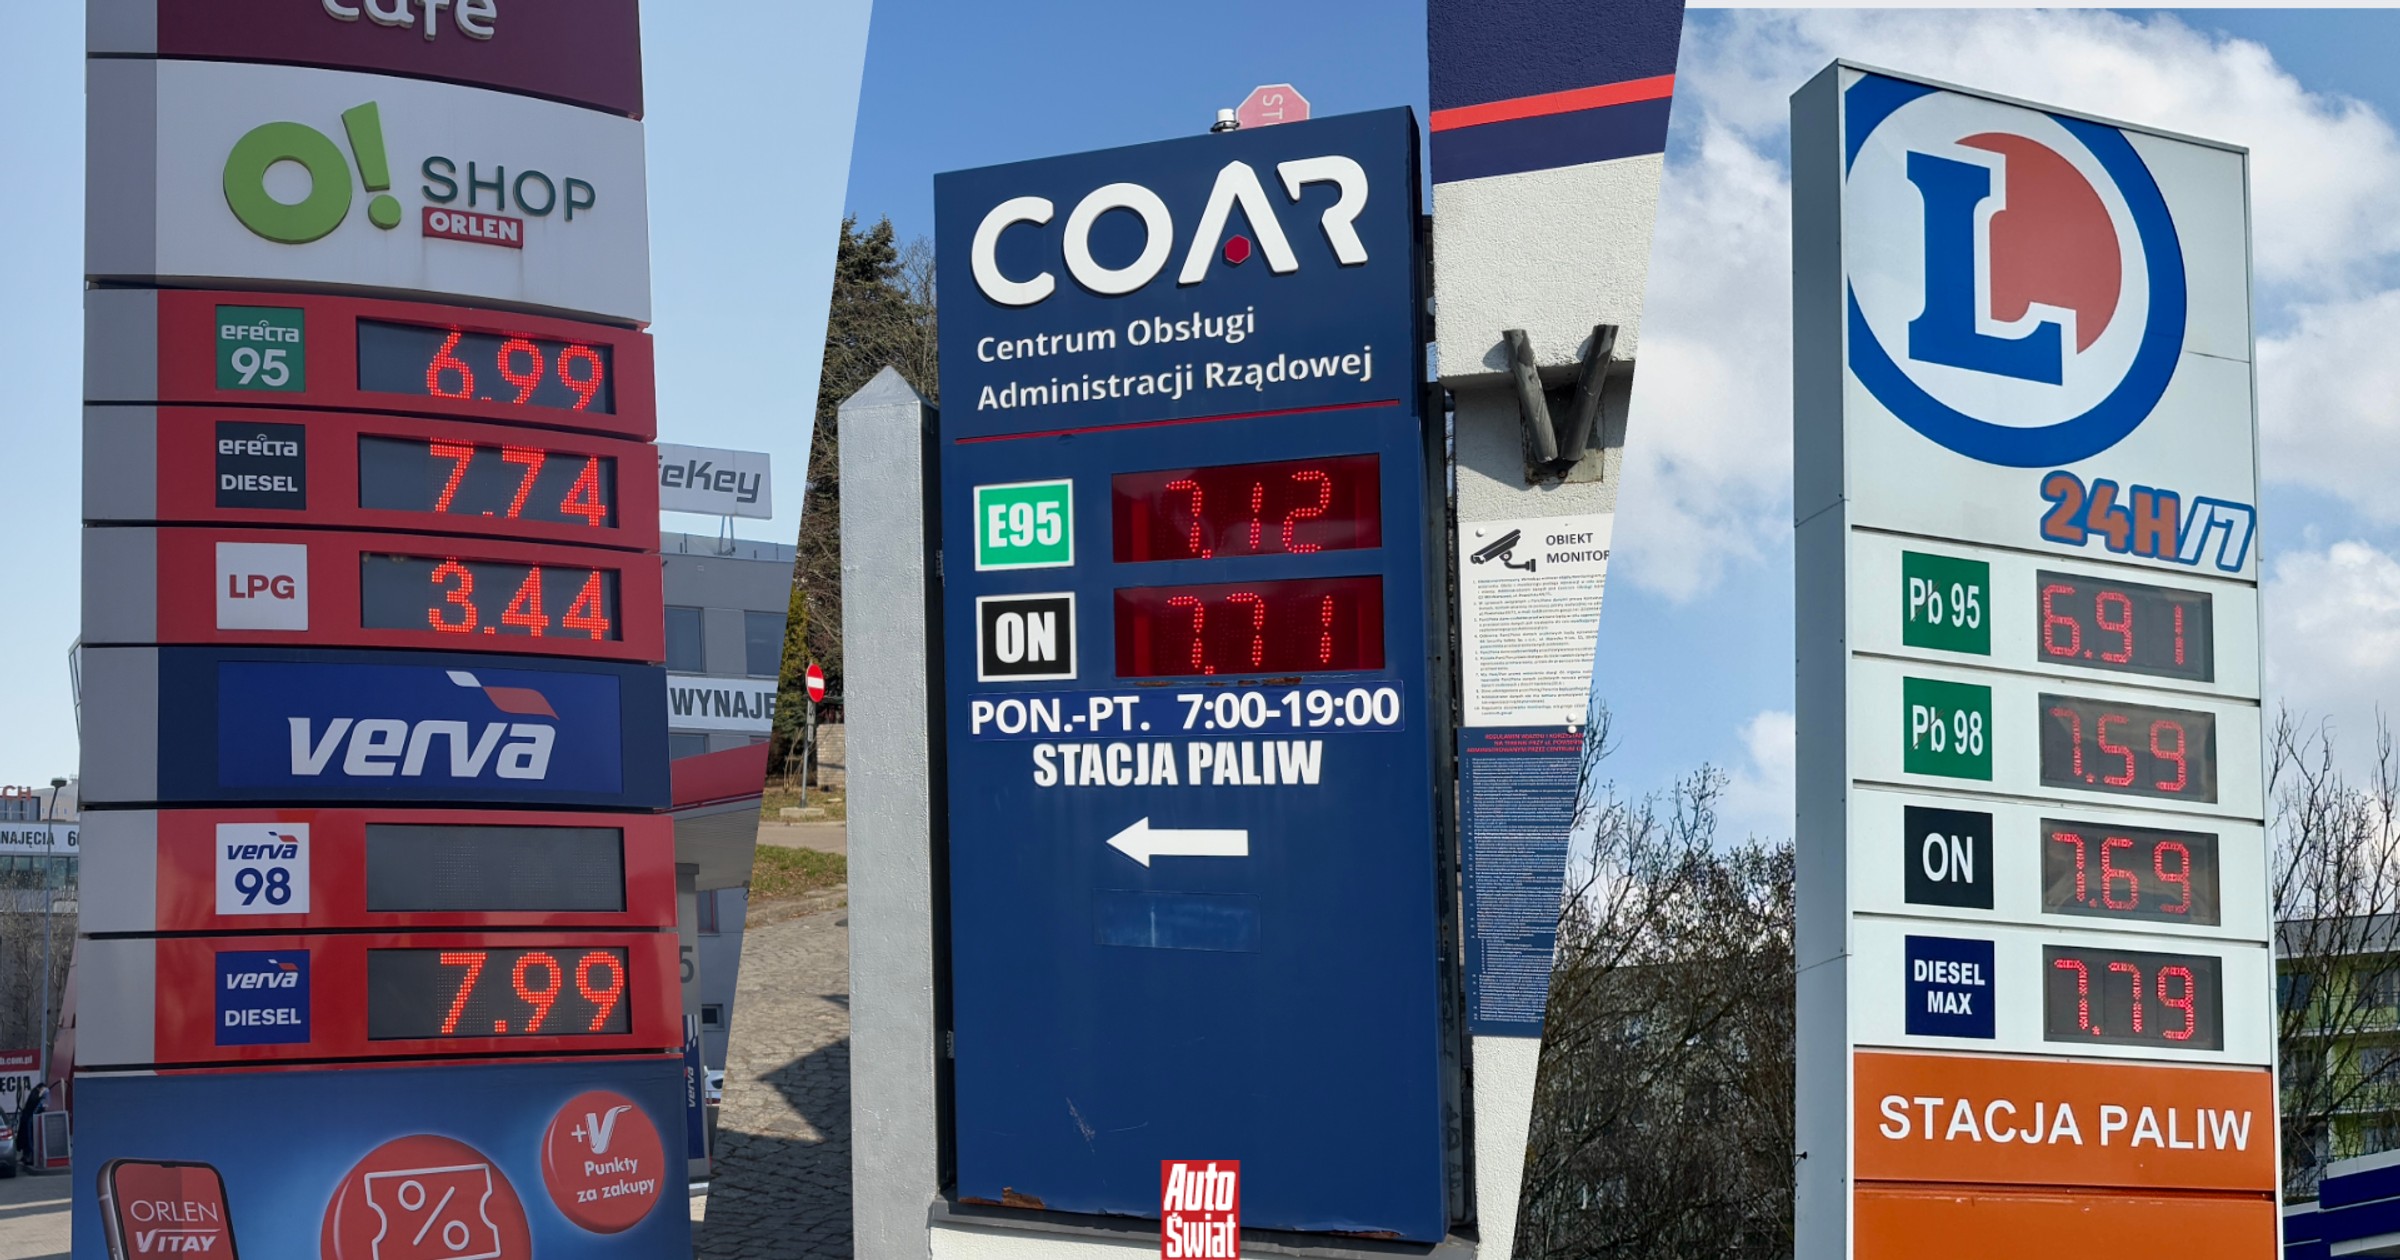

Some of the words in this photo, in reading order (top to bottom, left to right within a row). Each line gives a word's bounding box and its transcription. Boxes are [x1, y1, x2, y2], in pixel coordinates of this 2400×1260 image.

[1262, 94, 1283, 126] ST
[223, 101, 401, 244] O!
[421, 156, 596, 222] SHOP
[428, 211, 519, 243] ORLEN
[971, 155, 1368, 306] COAR
[977, 325, 1116, 363] Centrum
[1127, 307, 1256, 346] Obsługi
[231, 347, 289, 387] 95
[426, 324, 603, 410] 6.99
[977, 363, 1193, 411] Administracji
[1205, 346, 1372, 392] Rządowej
[221, 474, 298, 492] DIESEL
[430, 437, 607, 526] 7.74
[658, 455, 761, 503] eKey
[987, 501, 1062, 548] E95
[1166, 470, 1331, 559] 7.12
[1546, 532, 1594, 546] OBIEKT
[2041, 470, 2256, 573] 24H/7
[229, 574, 295, 600] LPG
[428, 556, 609, 640] 3.44
[1910, 577, 1943, 624] Pb
[1951, 582, 1981, 629] 95
[995, 612, 1057, 662] ON
[1167, 592, 1332, 674] 7.71
[2042, 584, 2184, 665] 6.91
[971, 698, 1150, 735] PON.-PT.
[1177, 688, 1400, 731] 7:00-19:00
[1912, 705, 1946, 752] Pb
[1953, 709, 1983, 756] 98
[287, 717, 556, 780] verva
[1034, 742, 1178, 786] STACJA
[1189, 740, 1322, 785] PALIW
[2049, 707, 2186, 791] 7.59
[67, 830, 79, 847] 6
[227, 842, 298, 861] verva
[1922, 832, 1973, 883] ON
[234, 867, 291, 906] 98
[2052, 832, 2190, 914] 7.69
[226, 971, 298, 990] verva
[440, 951, 624, 1034] 7.99
[1914, 959, 1985, 986] DIESEL
[225, 1008, 301, 1027] DIESEL
[1927, 990, 1972, 1015] MAX
[2053, 959, 2194, 1039] 7.79
[1879, 1095, 2082, 1147] STACJA
[2100, 1104, 2251, 1151] PALIW
[577, 1188, 598, 1203] za
[601, 1178, 655, 1199] zakupy
[584, 1157, 638, 1177] Punkty
[130, 1199, 219, 1223] ORLEN
[135, 1228, 221, 1253] VITAY
